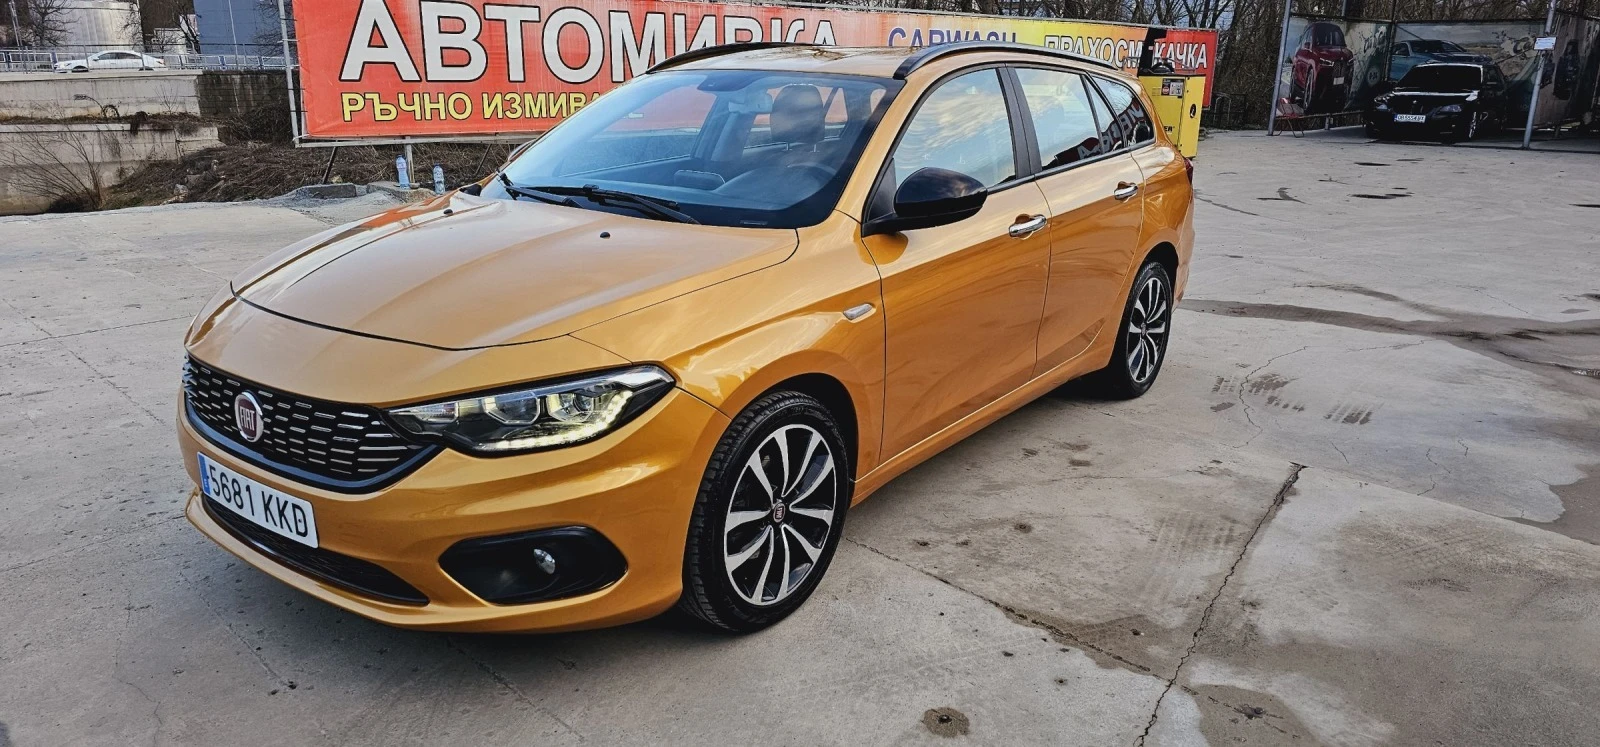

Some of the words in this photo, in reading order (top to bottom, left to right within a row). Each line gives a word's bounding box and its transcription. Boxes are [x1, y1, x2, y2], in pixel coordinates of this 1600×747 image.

[1045, 34, 1208, 69] РАХОСМКАЧКА
[341, 92, 473, 122] РЪЧНО
[239, 406, 255, 431] FIAT
[208, 464, 256, 518] 5681
[261, 490, 308, 538] KKD
